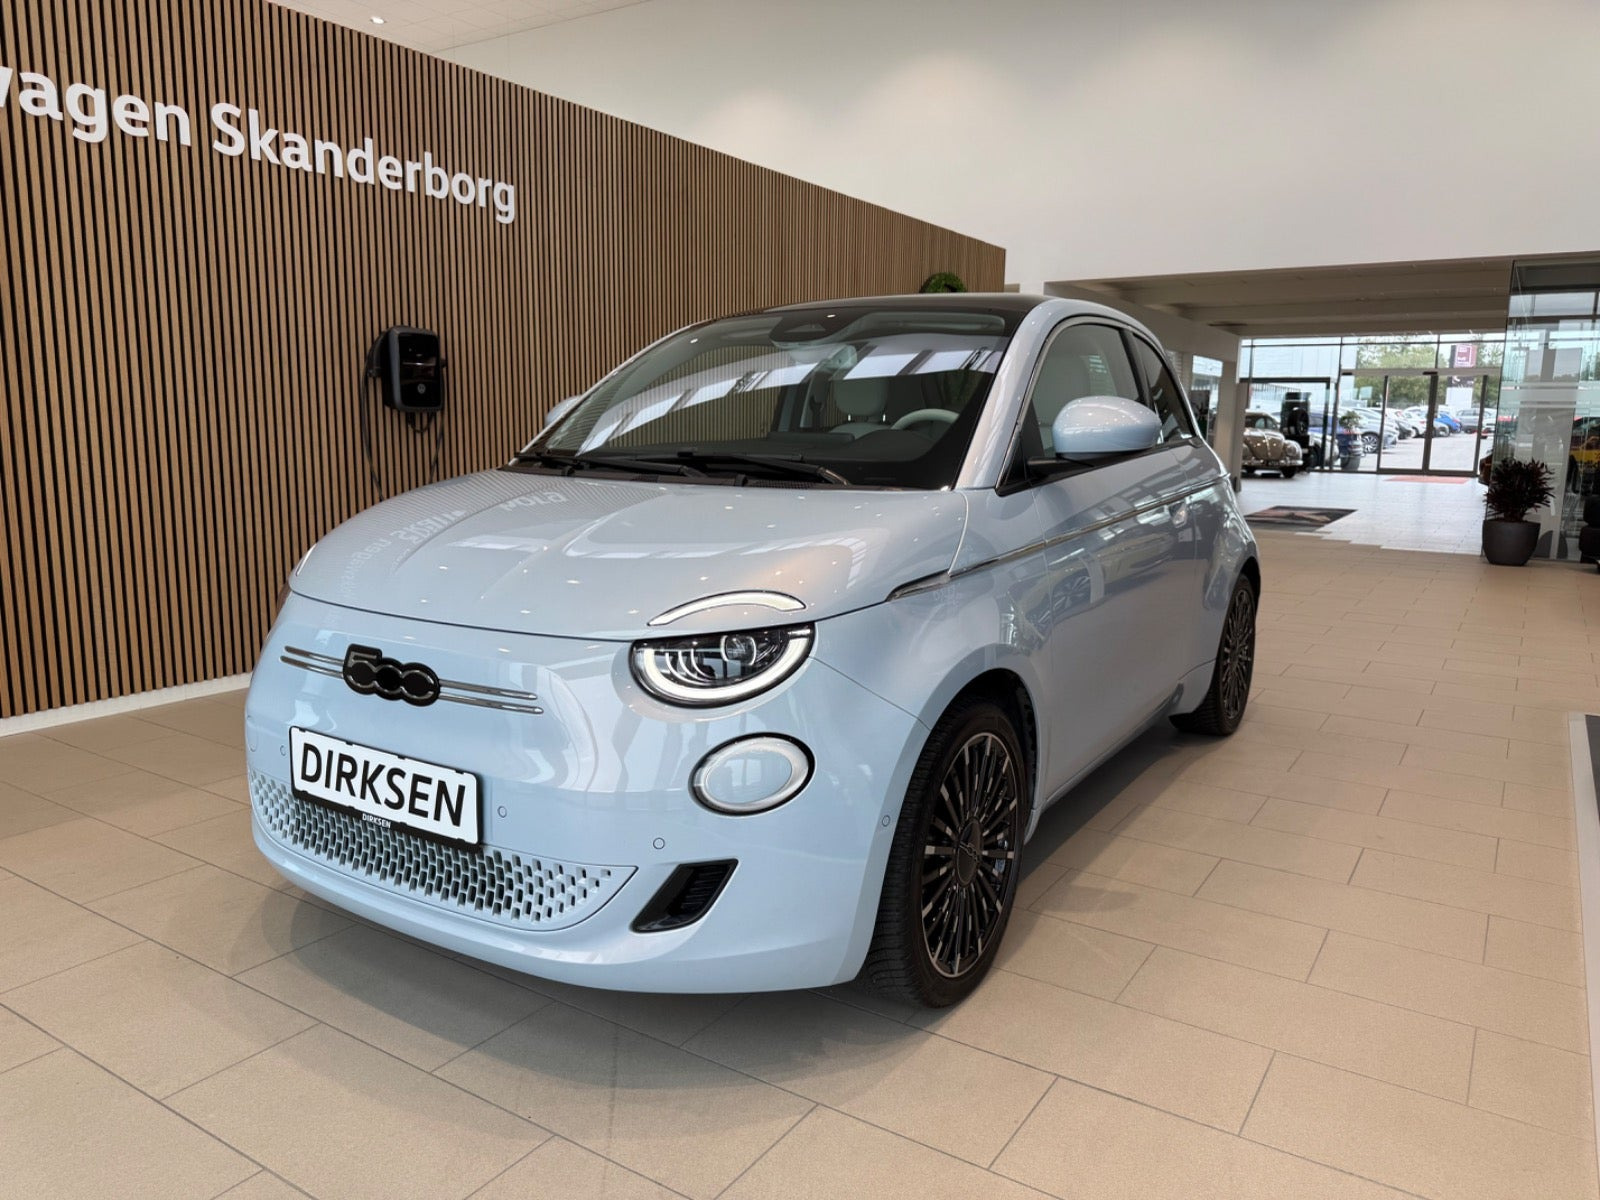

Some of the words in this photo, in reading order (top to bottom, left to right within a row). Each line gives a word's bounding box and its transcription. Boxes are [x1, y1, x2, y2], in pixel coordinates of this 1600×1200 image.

[0, 66, 191, 145] agen
[211, 102, 515, 224] Skanderborg
[343, 644, 440, 706] 500
[301, 742, 466, 827] DIRKSEN
[362, 813, 391, 828] DIRKSEN
